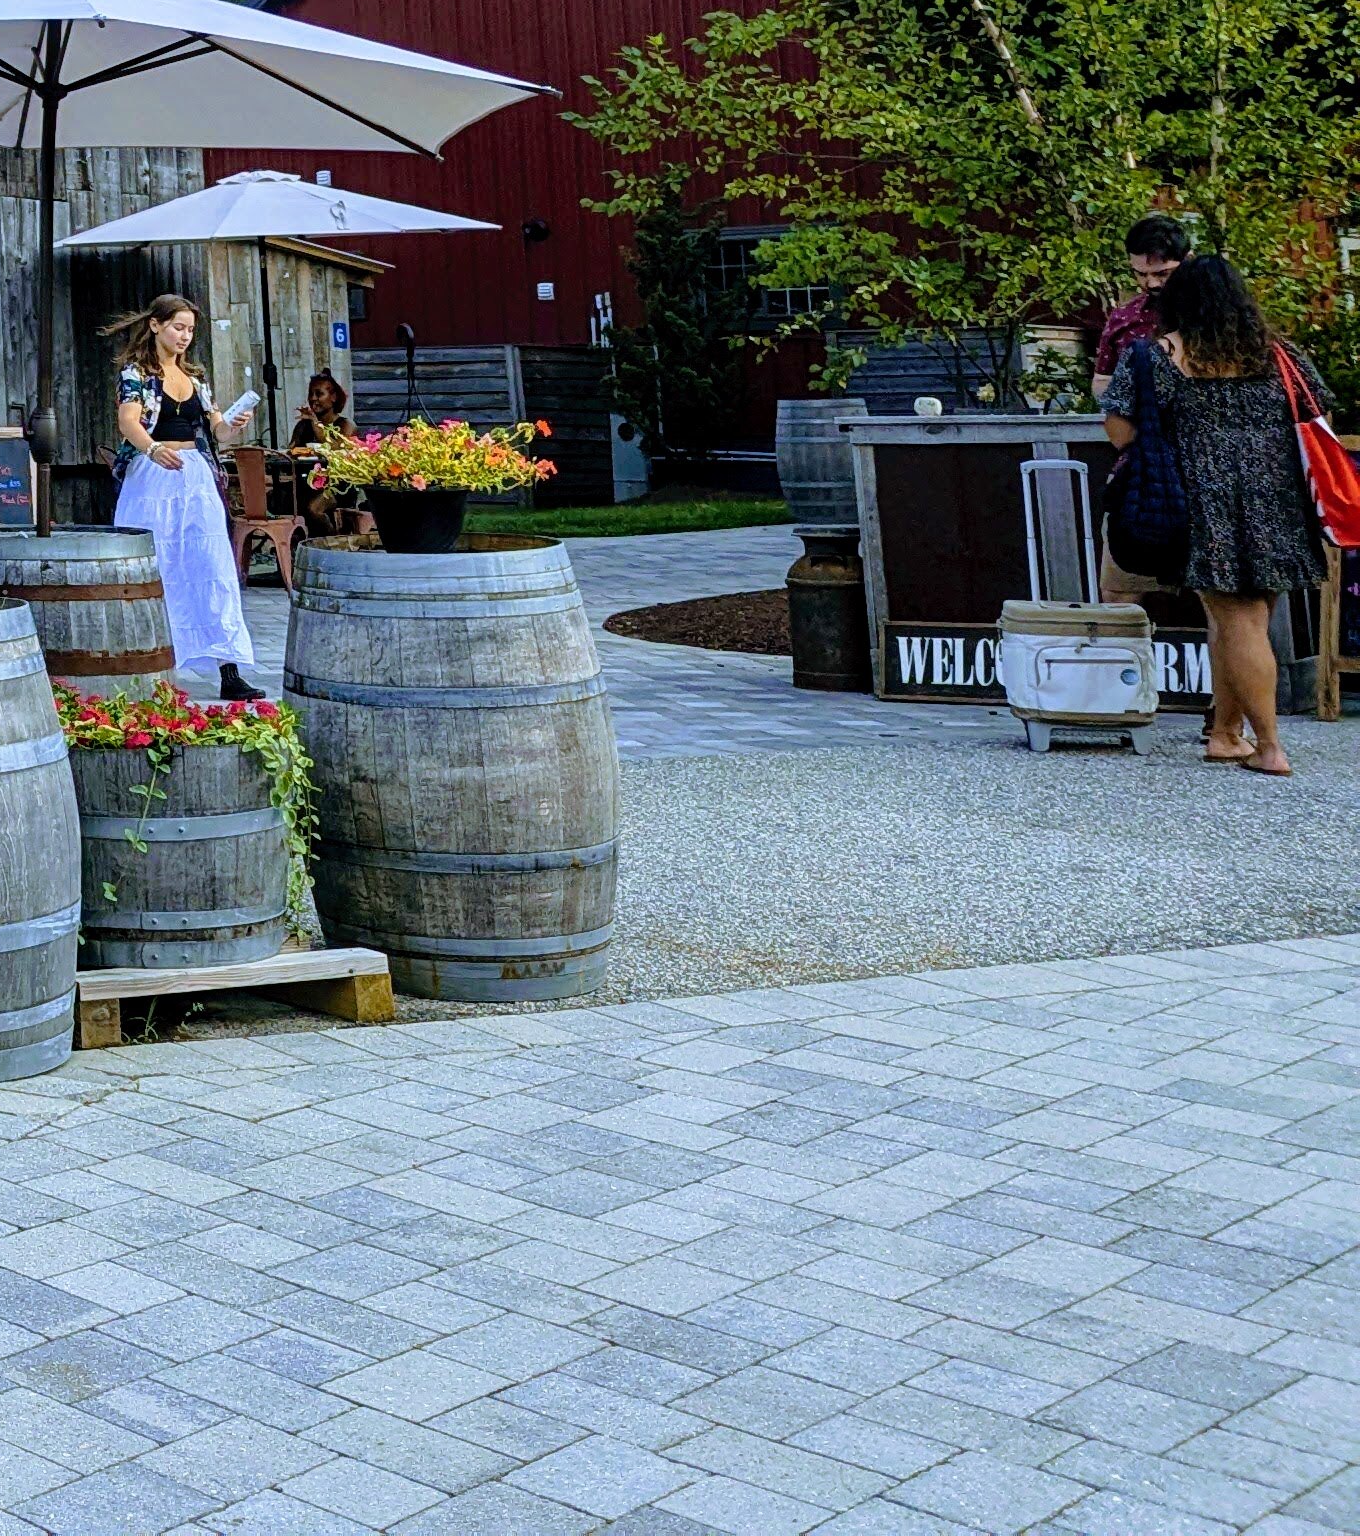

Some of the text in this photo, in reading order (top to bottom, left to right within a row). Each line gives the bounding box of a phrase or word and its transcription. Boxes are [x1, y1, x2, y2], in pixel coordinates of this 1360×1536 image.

[336, 328, 345, 343] 6
[895, 636, 1214, 694] WELC RM
